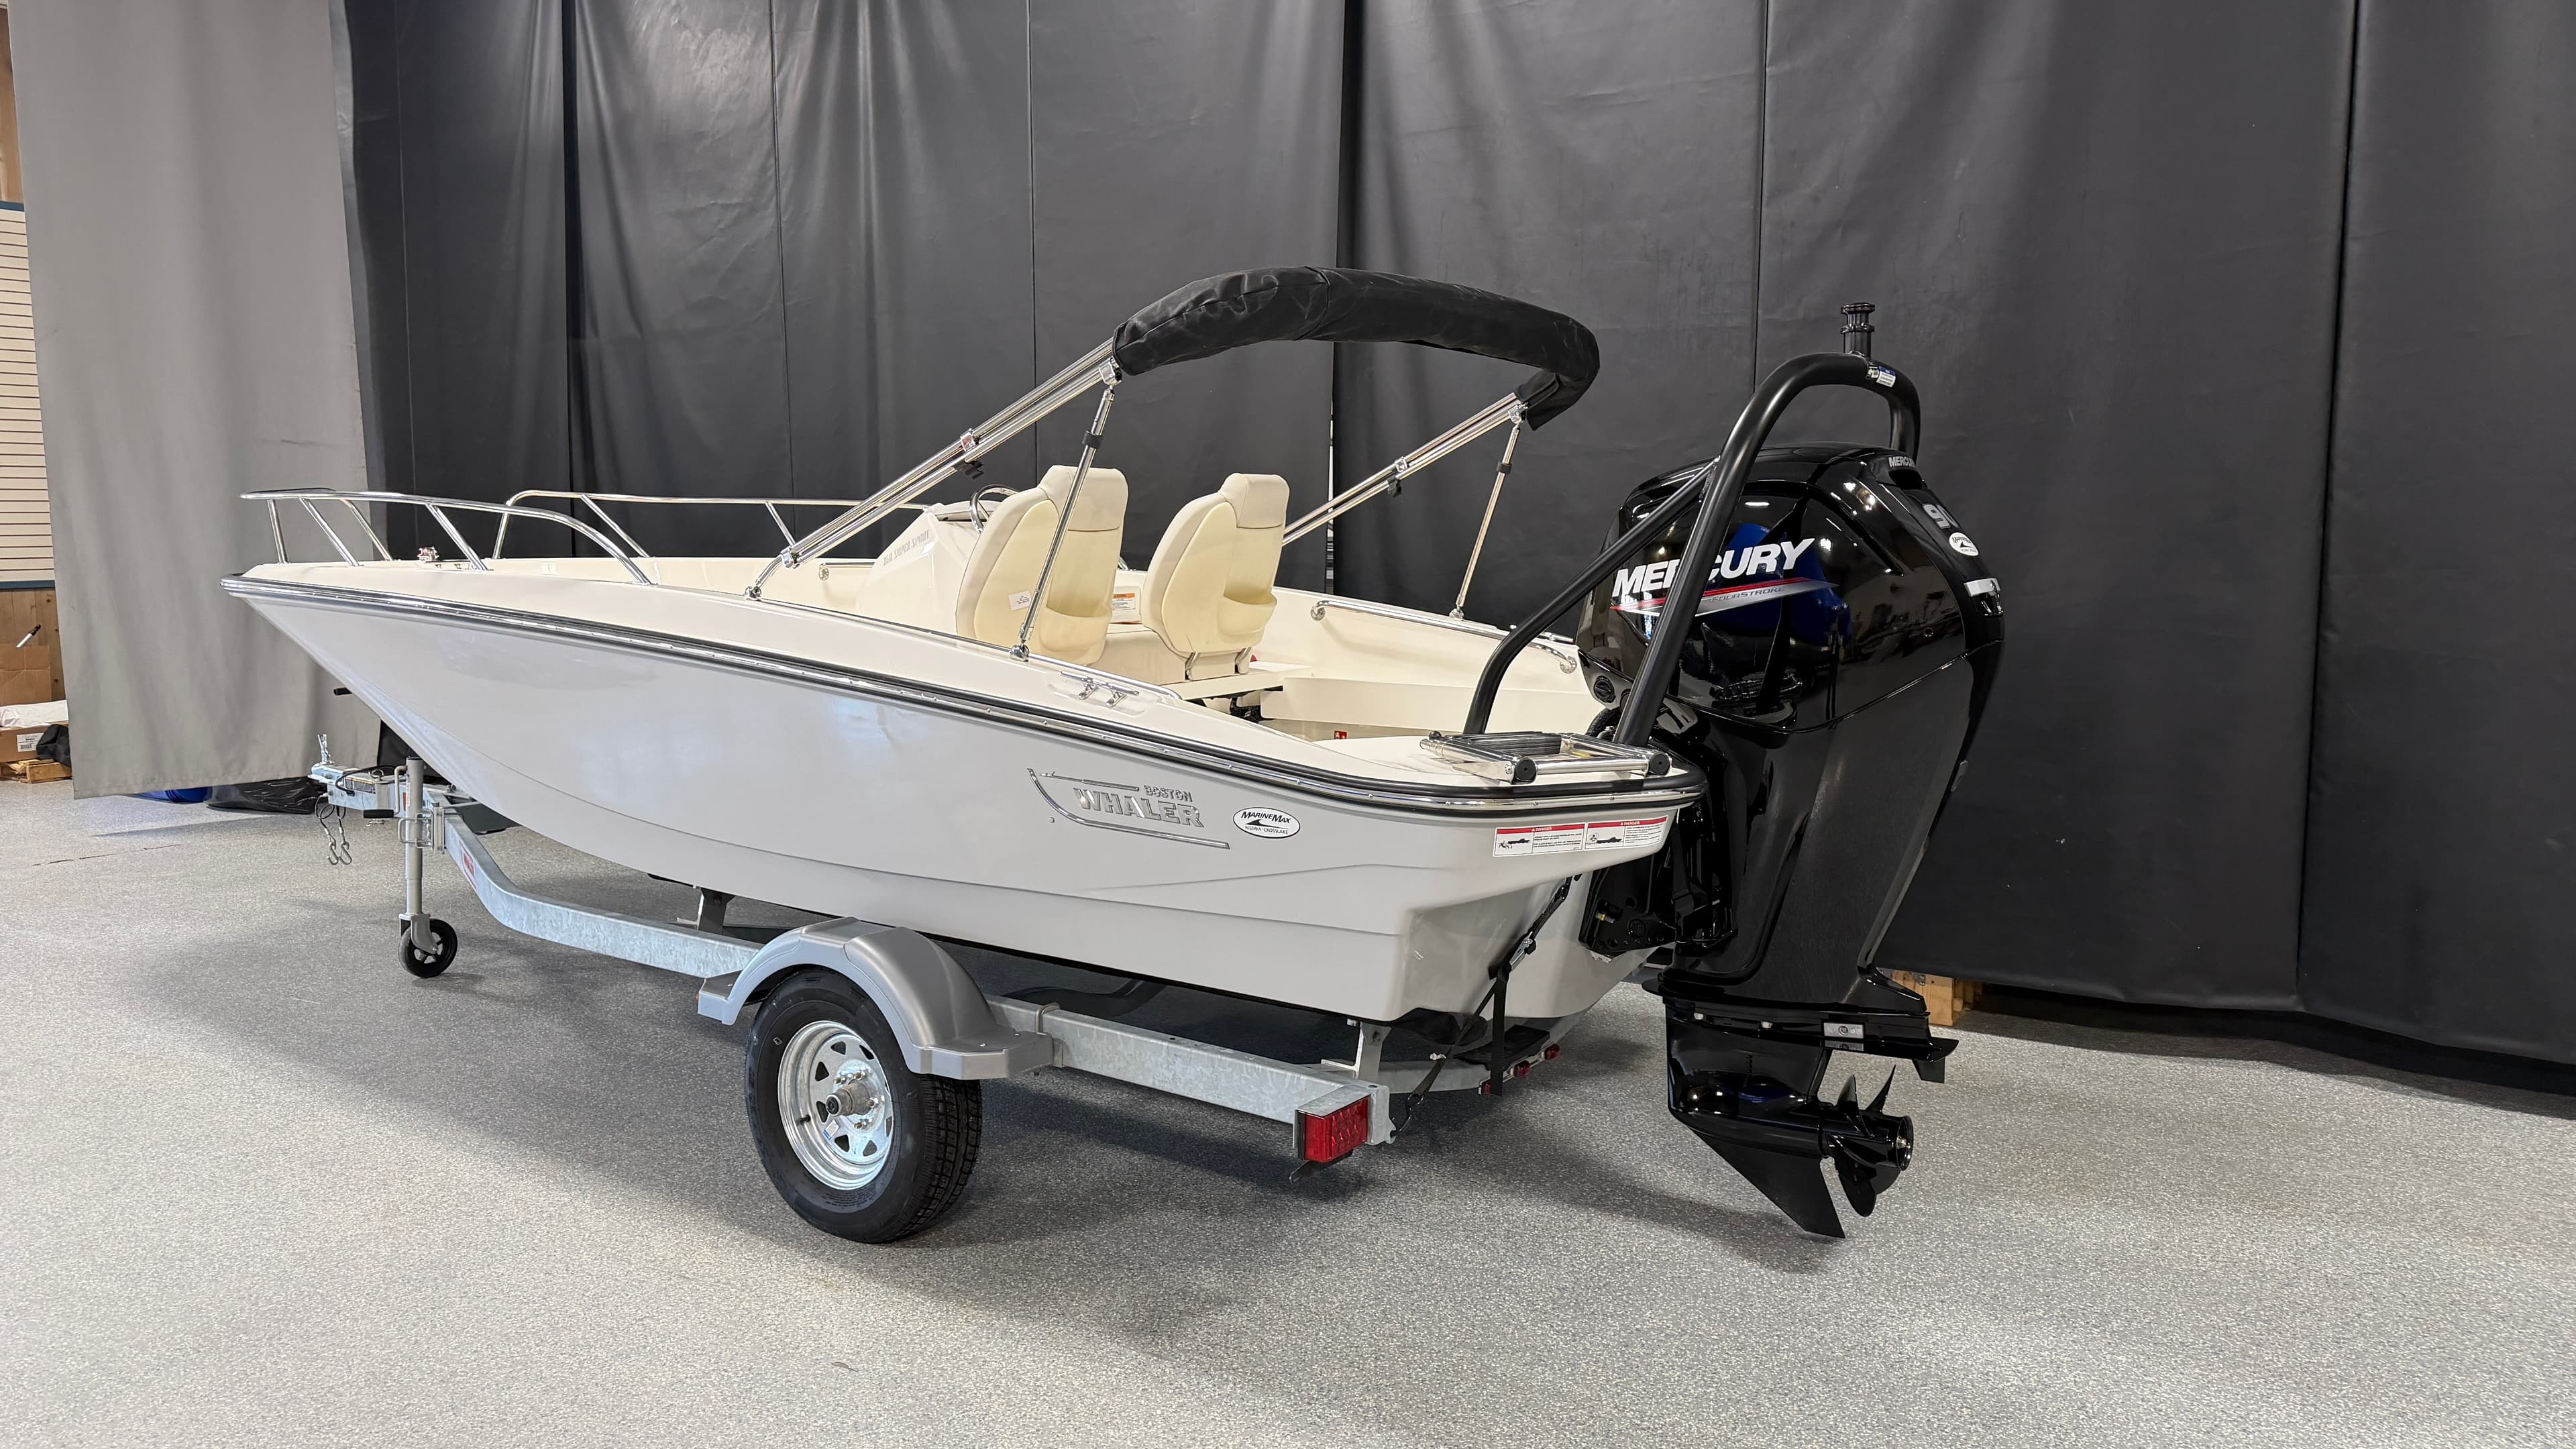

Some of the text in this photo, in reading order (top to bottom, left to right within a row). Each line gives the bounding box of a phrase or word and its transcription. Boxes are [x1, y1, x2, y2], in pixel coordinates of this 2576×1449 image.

[1888, 455, 1915, 468] MERCUR
[1922, 504, 1960, 529] 90
[1710, 585, 1785, 602] FOURSTROKE
[1143, 785, 1193, 802] BOSTON
[1073, 787, 1205, 828] WHALER
